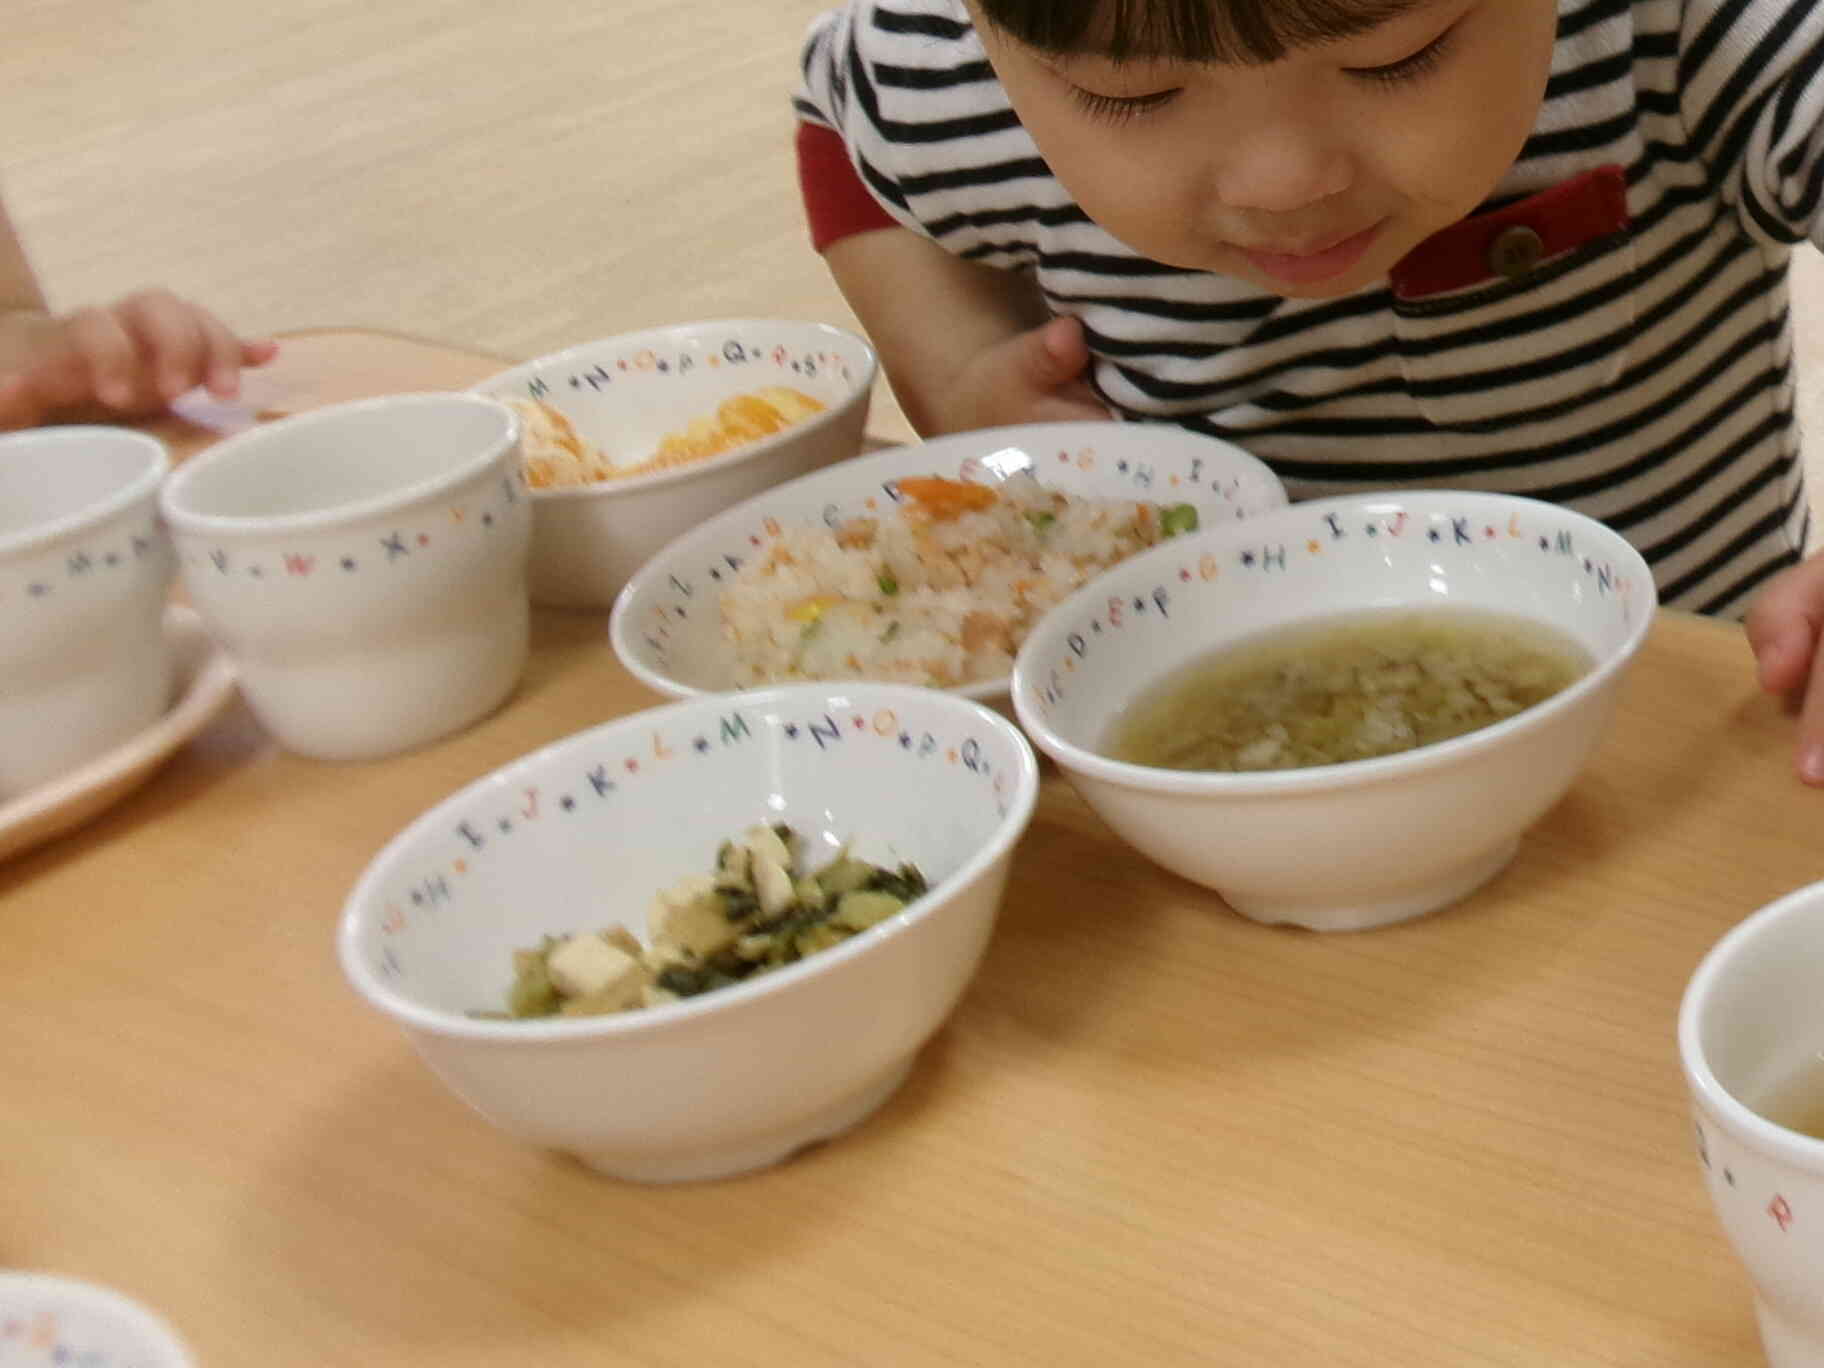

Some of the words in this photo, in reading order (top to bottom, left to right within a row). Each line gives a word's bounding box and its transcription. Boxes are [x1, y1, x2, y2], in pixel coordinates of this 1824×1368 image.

[722, 339, 748, 365] Q
[1066, 632, 1087, 660] D
[1262, 543, 1286, 572] H
[1323, 511, 1344, 540] I
[1450, 516, 1472, 547] K
[584, 761, 617, 800] K
[719, 711, 752, 746] M
[807, 713, 842, 751] N
[872, 707, 898, 737] O
[961, 736, 980, 773] Q
[1766, 1192, 1795, 1233] R
